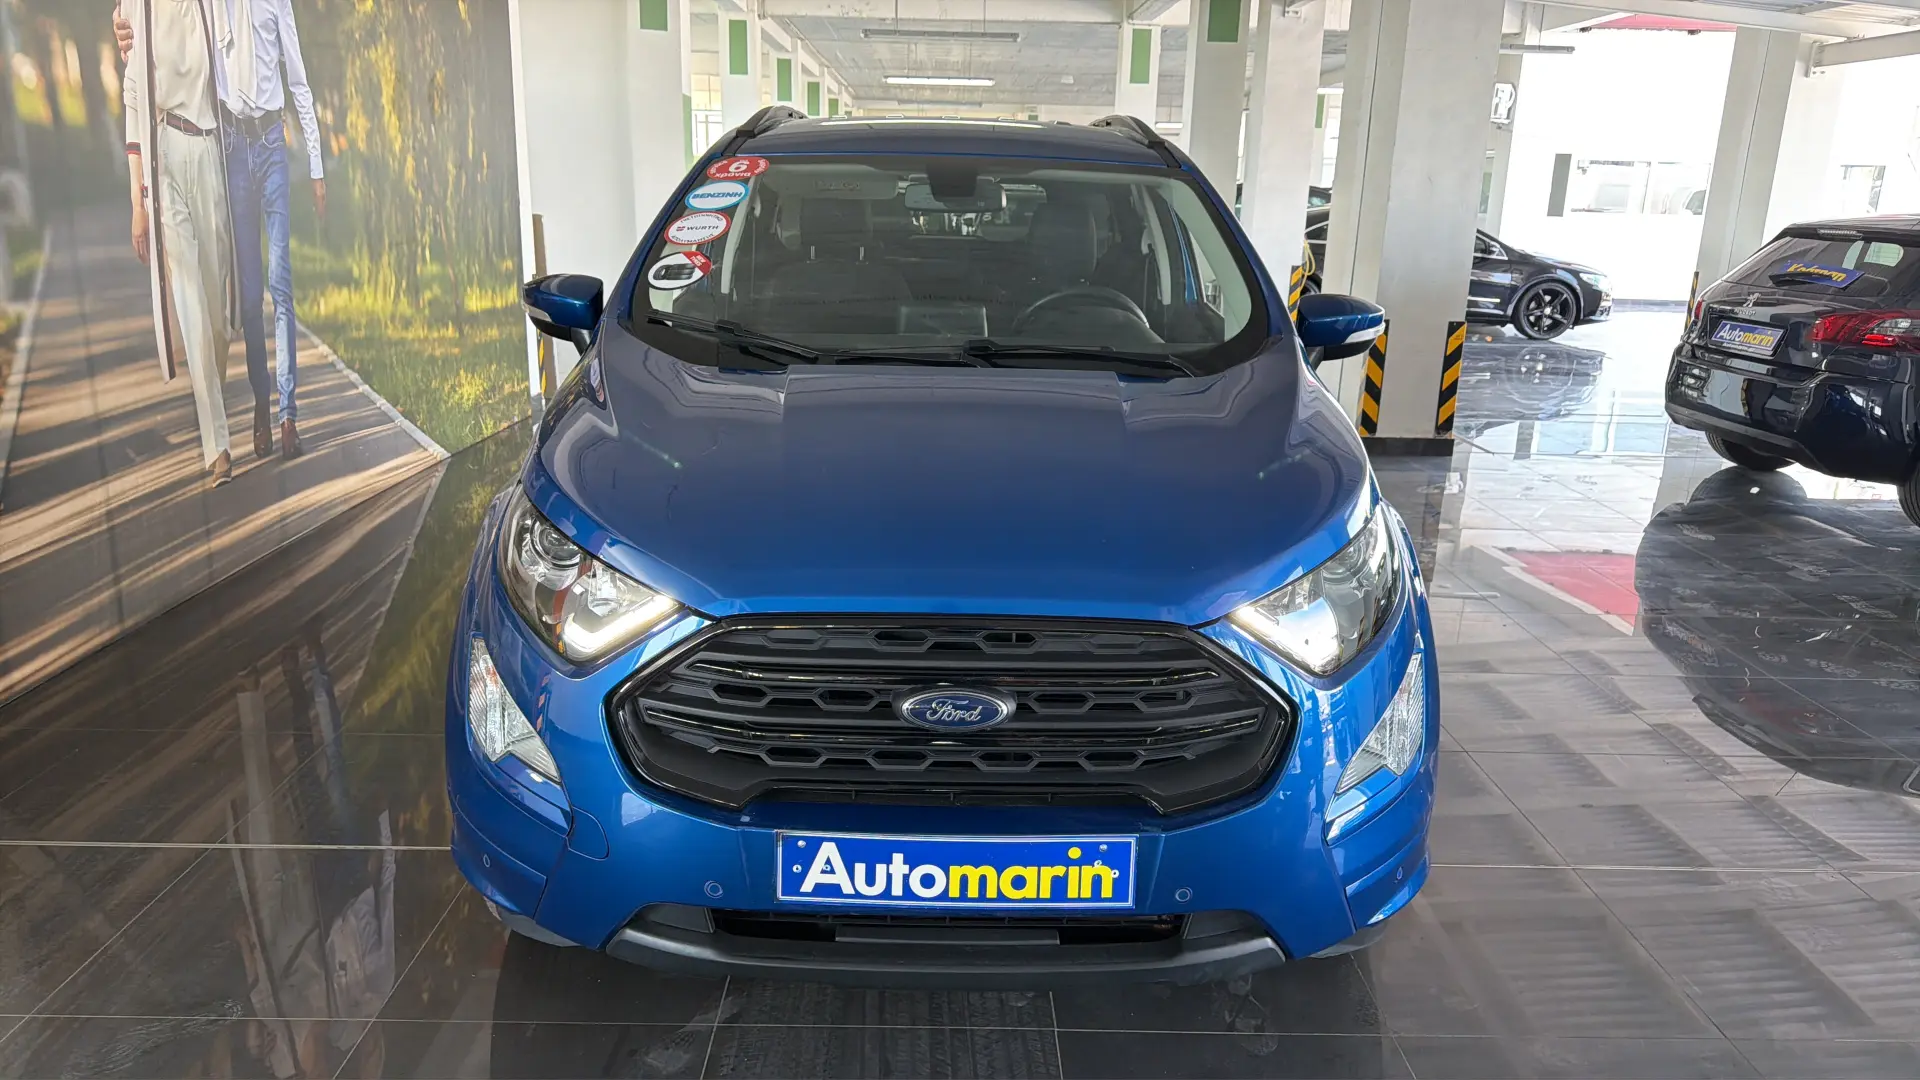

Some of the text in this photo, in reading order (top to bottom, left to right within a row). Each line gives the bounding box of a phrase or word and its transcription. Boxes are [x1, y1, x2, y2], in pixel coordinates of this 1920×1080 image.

[729, 161, 750, 172] 6
[1717, 324, 1774, 347] Automarin
[926, 698, 982, 721] Ford
[800, 842, 1113, 900] Automarin
